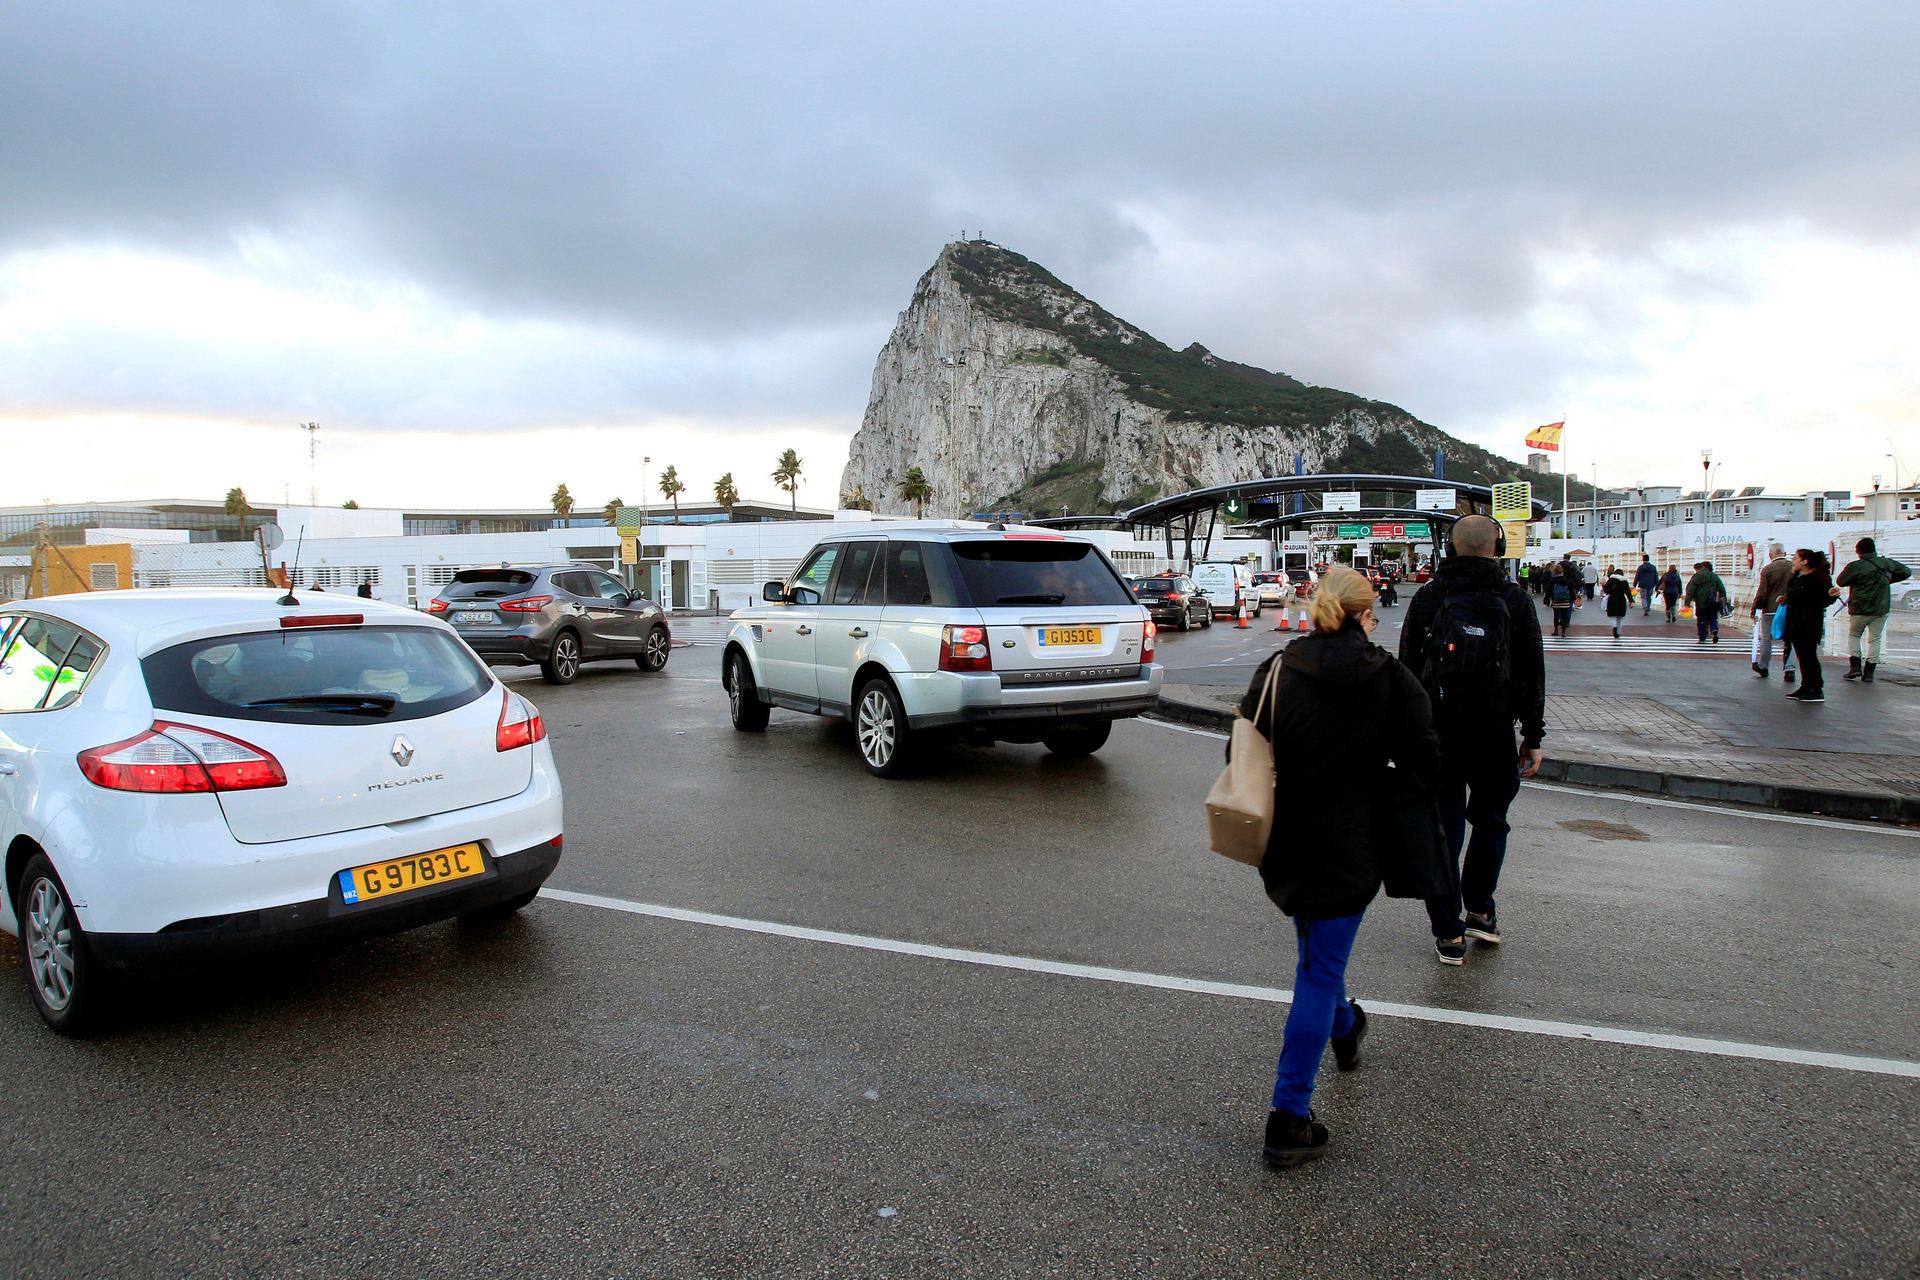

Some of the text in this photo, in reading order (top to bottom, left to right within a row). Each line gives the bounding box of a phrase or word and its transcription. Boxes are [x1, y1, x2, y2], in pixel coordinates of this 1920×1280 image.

[1694, 535, 1744, 544] ADUANA
[1024, 668, 1120, 679] RANGE ROVER
[368, 772, 445, 792] MEGANE
[343, 889, 358, 899] GBZ
